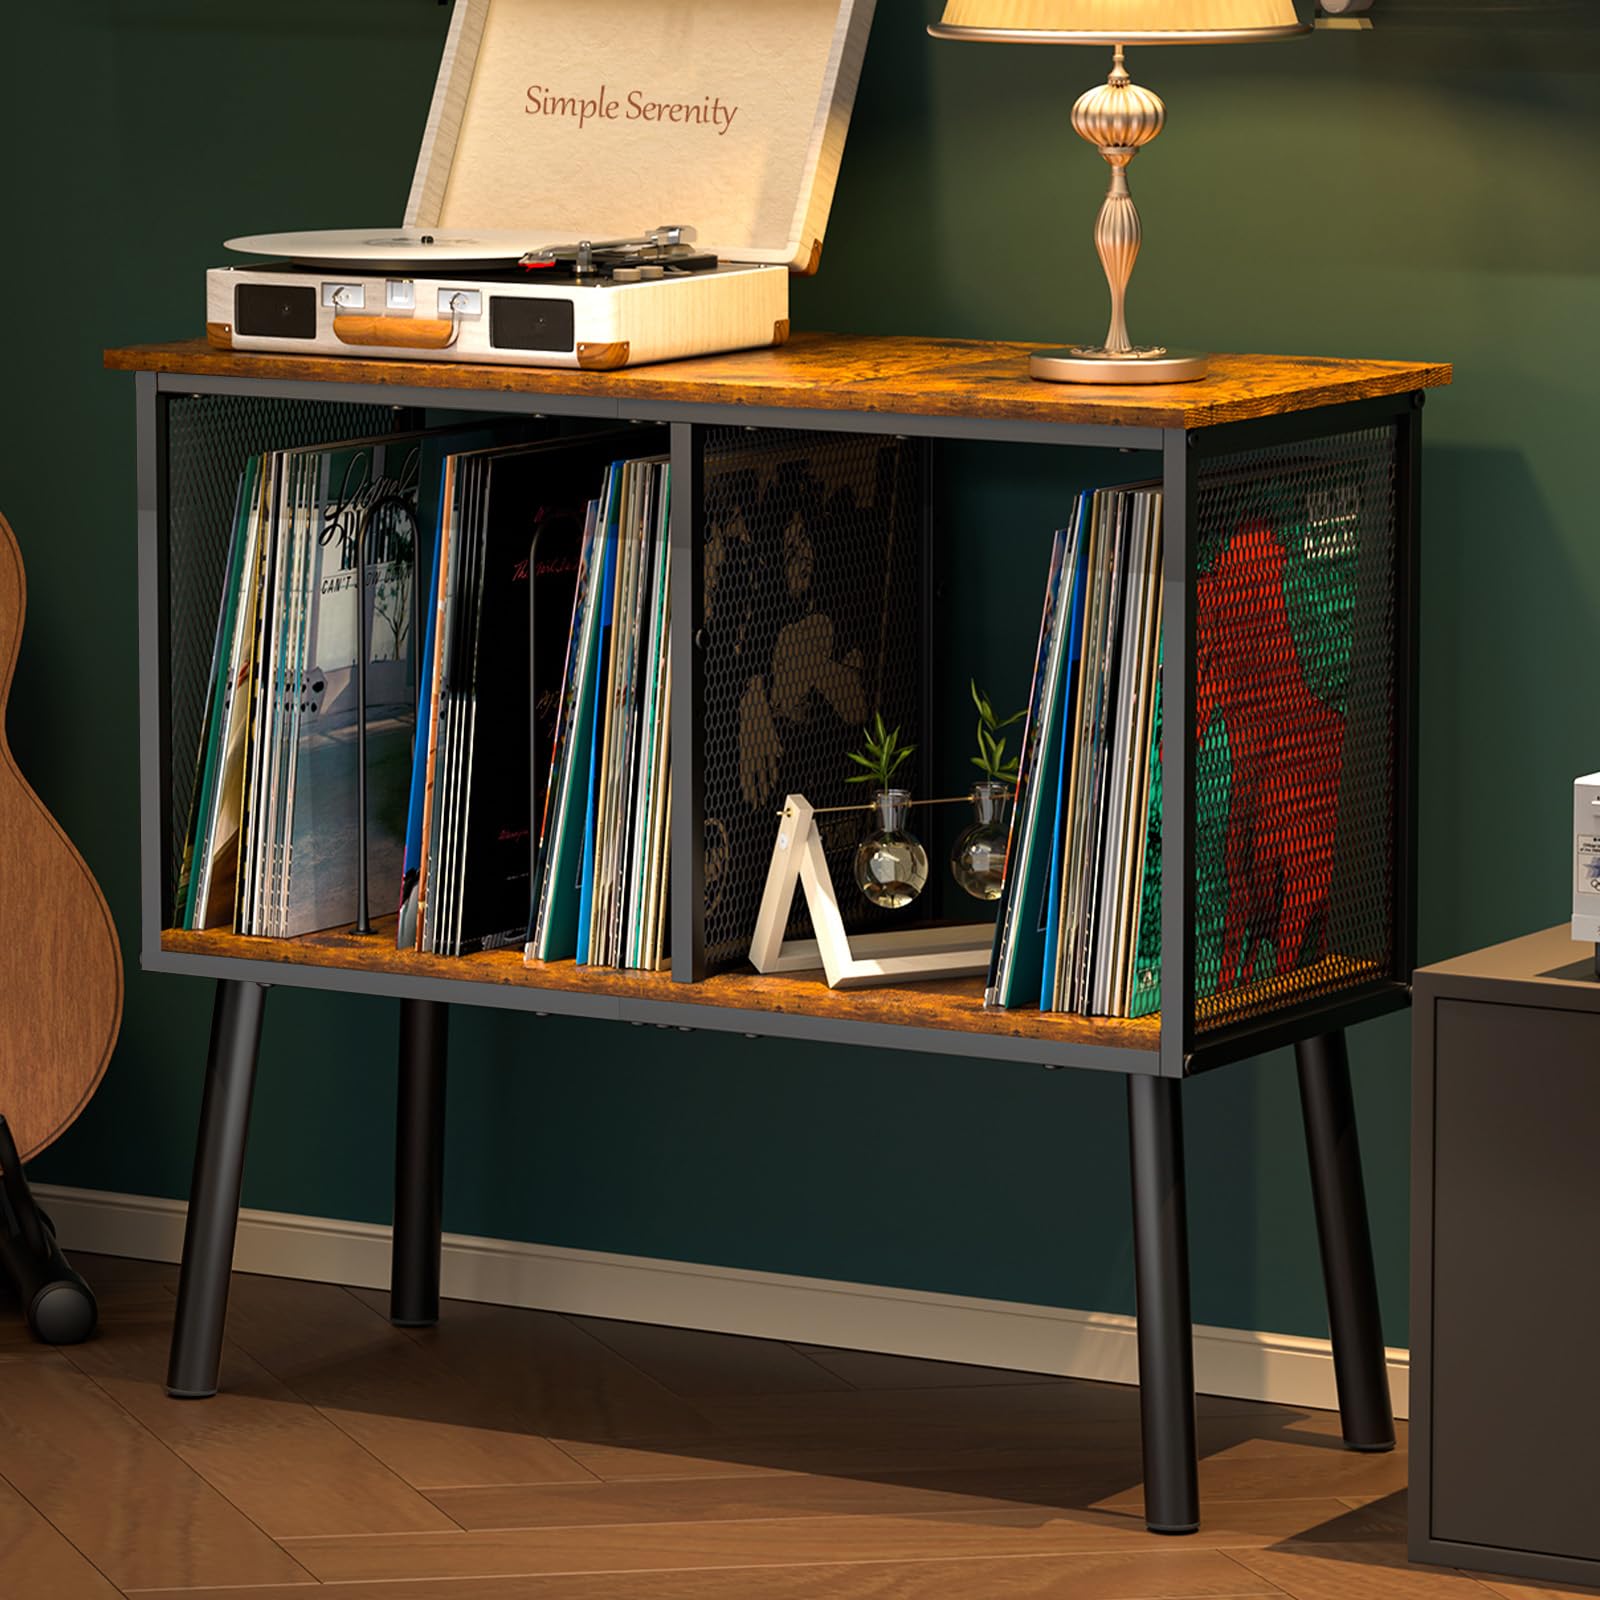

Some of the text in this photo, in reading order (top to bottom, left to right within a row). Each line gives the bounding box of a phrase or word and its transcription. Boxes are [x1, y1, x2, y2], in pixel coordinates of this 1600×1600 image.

[525, 85, 738, 135] Simple Serenity
[321, 576, 352, 595] CAN'T
